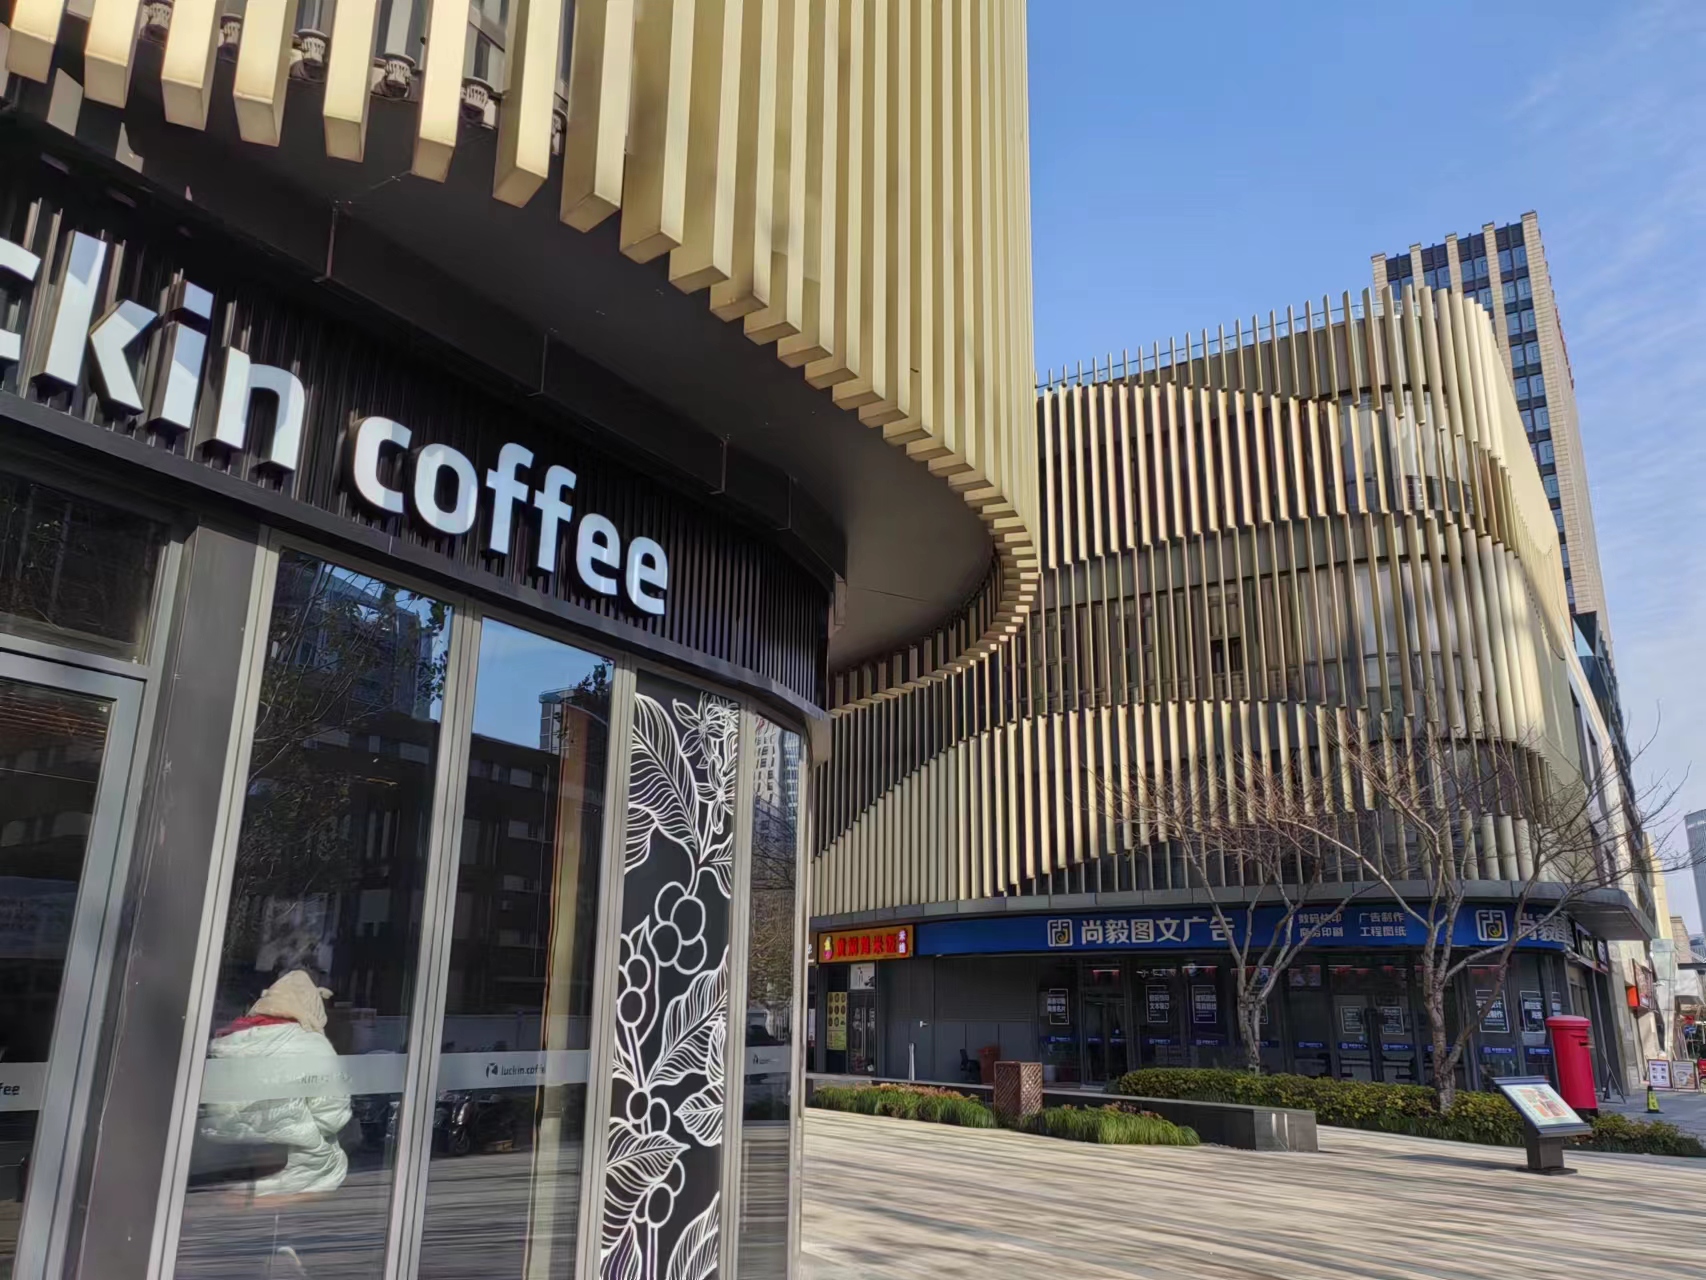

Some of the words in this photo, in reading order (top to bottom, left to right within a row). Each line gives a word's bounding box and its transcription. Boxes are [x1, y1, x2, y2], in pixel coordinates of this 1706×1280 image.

[351, 416, 669, 617] coffee
[1359, 912, 1405, 924] 广告制作
[1081, 915, 1236, 945] 尚毅图文广告
[1359, 926, 1407, 937] 工程图纸
